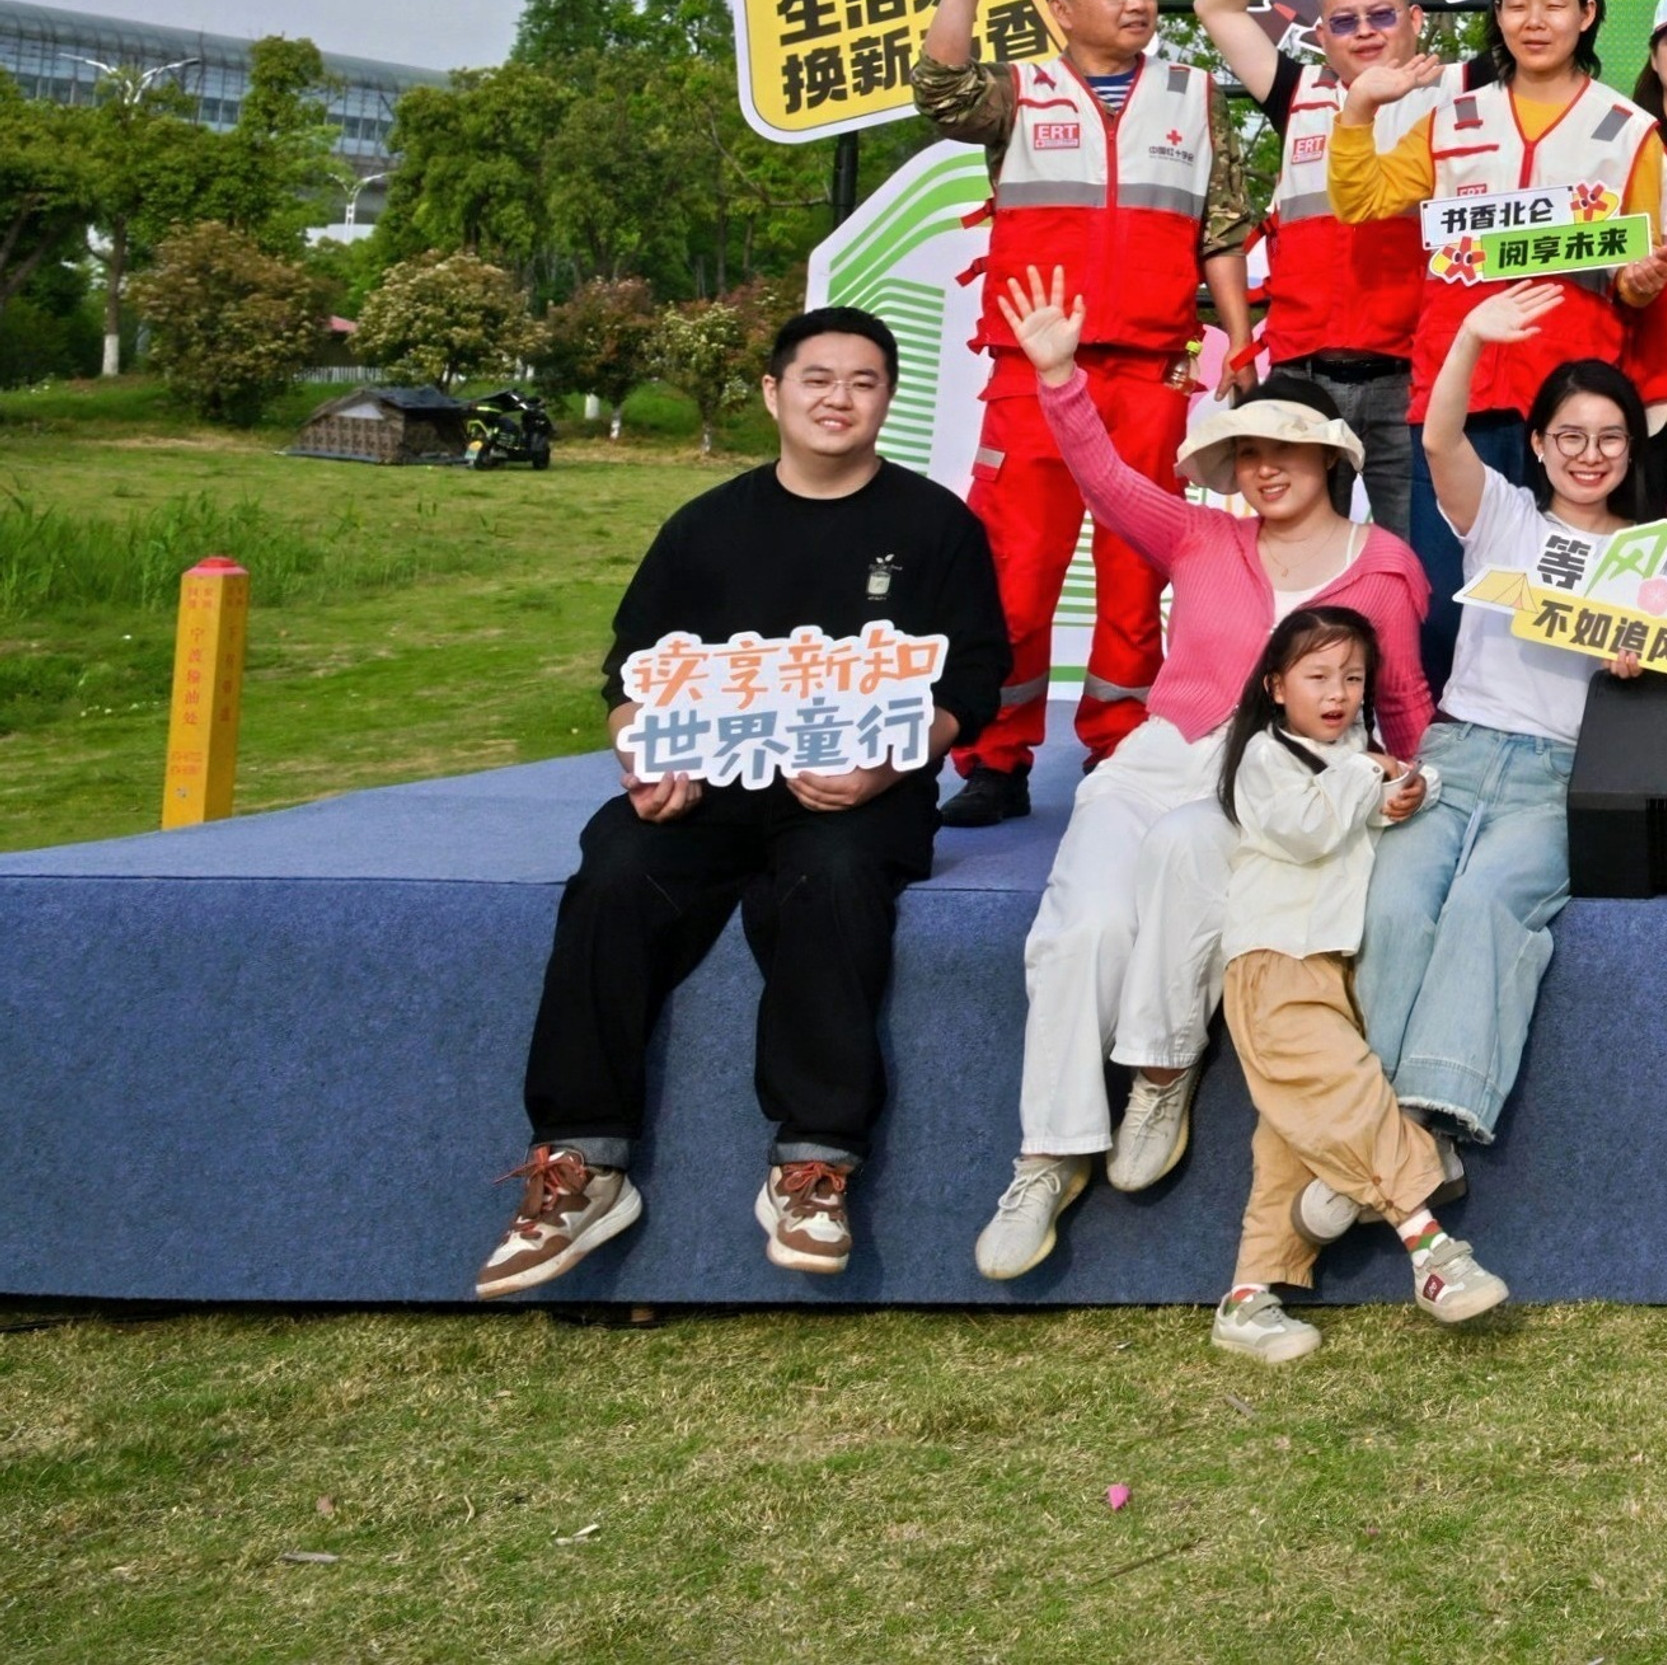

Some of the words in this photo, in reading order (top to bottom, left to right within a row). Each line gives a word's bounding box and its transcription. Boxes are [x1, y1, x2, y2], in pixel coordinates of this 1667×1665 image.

[1036, 124, 1078, 140] ERT
[1296, 136, 1326, 154] ERT
[1148, 145, 1195, 163] 中国红十字会
[1440, 197, 1554, 234] 书香北仑
[1498, 228, 1628, 269] 阅享未来
[632, 628, 940, 711] 读享新知
[627, 696, 925, 782] 世界童行
